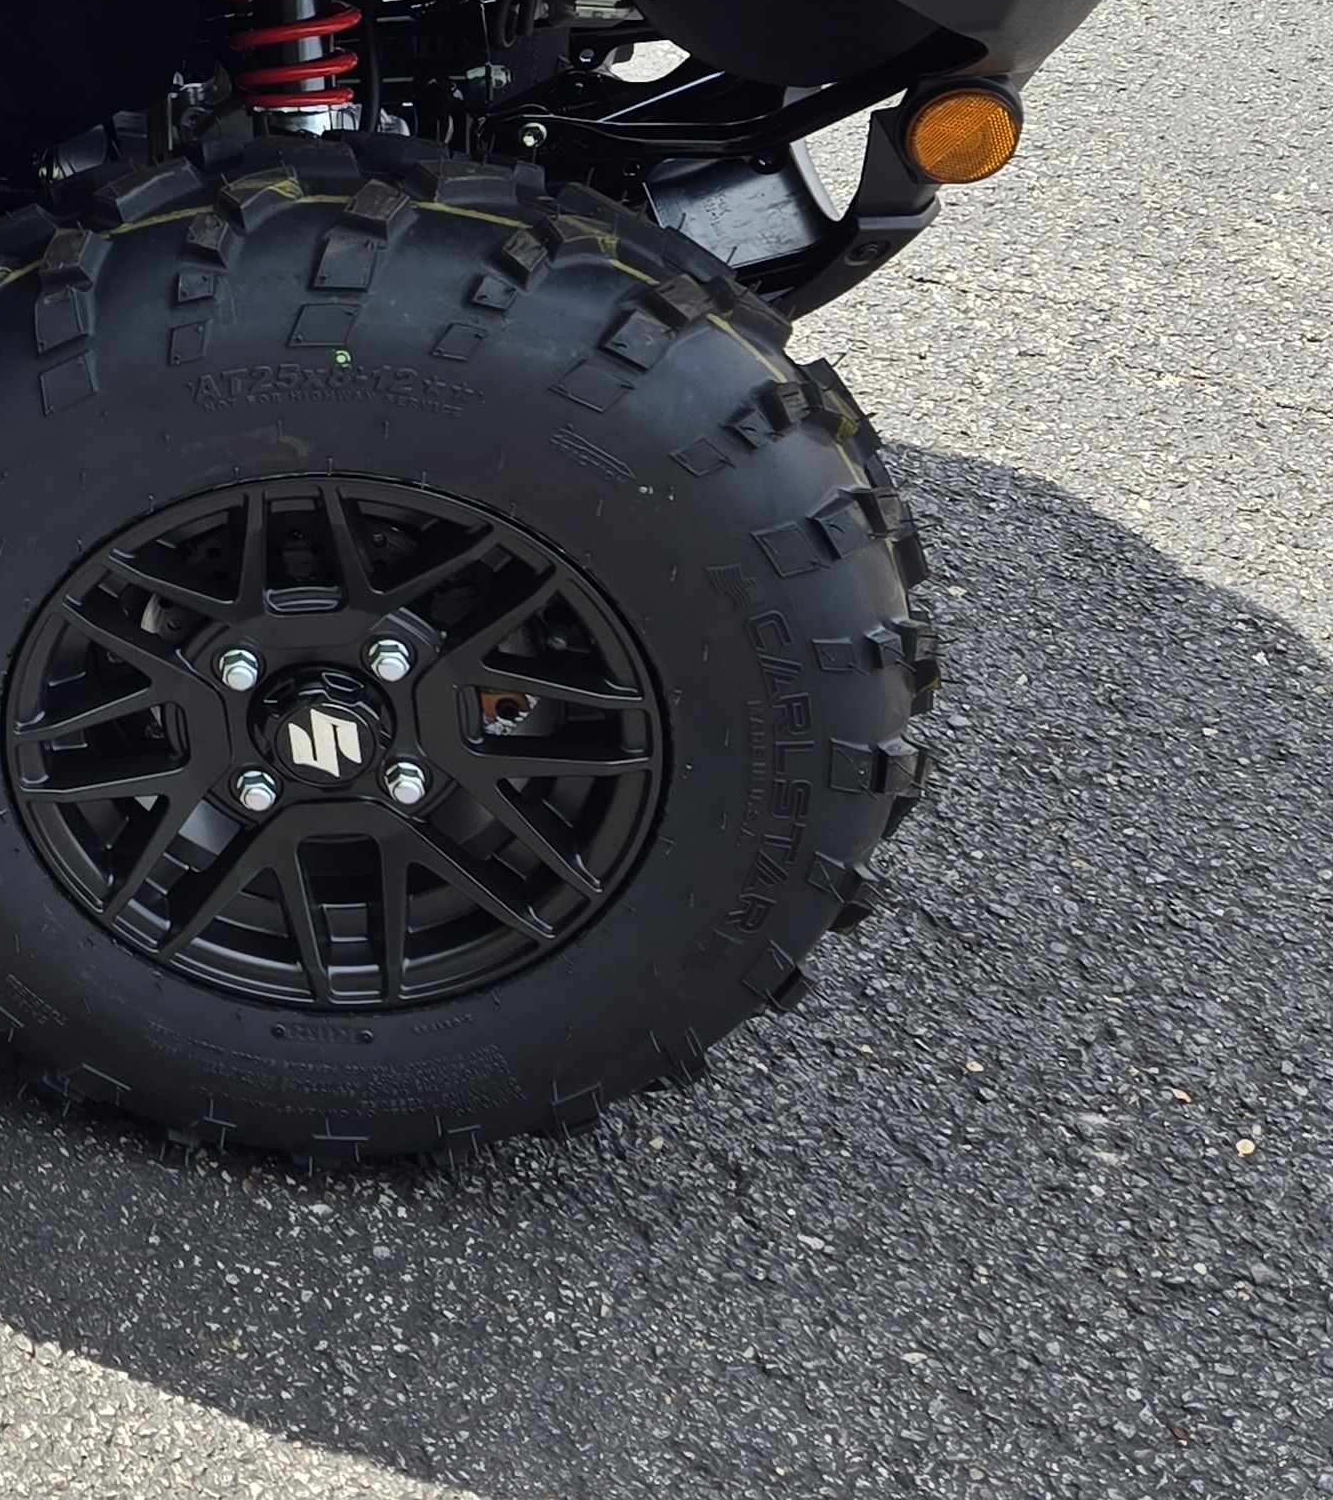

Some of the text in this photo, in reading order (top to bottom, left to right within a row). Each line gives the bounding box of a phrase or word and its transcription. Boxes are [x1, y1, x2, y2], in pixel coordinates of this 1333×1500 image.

[203, 389, 464, 418] NOT FOR HIGHWAY SERVICE
[726, 608, 815, 936] CARLSTAR
